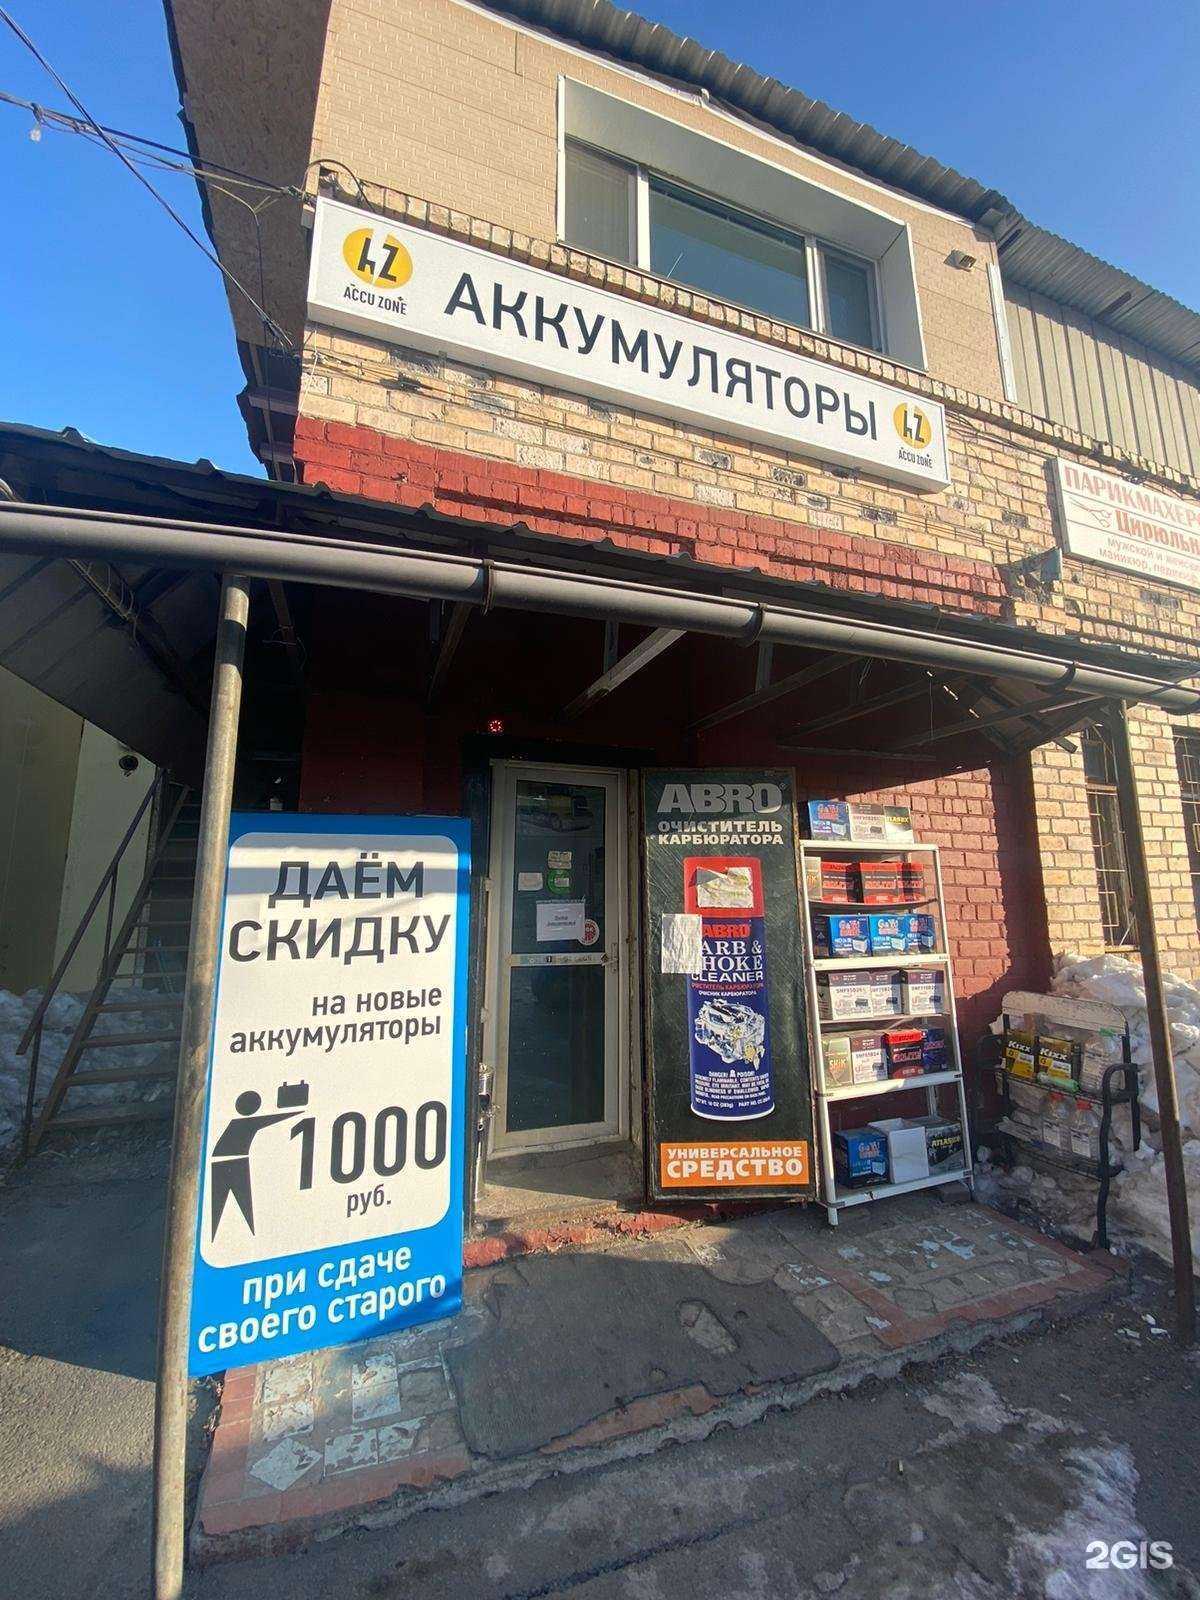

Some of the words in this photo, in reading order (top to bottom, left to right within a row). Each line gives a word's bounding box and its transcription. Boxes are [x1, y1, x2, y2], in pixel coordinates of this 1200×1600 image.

[343, 284, 375, 306] ACCU
[378, 296, 407, 315] ZONE
[443, 272, 878, 441] АККУМУЛЯТОРЫ
[656, 783, 783, 814] ABRO
[657, 820, 783, 834] ОЧИСТИТЕЛЬ
[657, 834, 784, 846] КАРБЮРАТОРА
[268, 852, 424, 909] ДАЁМ
[228, 914, 451, 965] СКИДКУ
[702, 924, 751, 938] ABRO
[700, 940, 747, 955] ARB
[751, 939, 763, 954] &
[692, 970, 764, 982] CLEANER
[701, 954, 763, 972] HOKE
[312, 994, 345, 1016] на
[356, 987, 442, 1013] новые
[229, 1015, 441, 1057] аккумуляторы
[667, 1146, 803, 1159] УНИВЕРСАЛЬНОЕ
[667, 1158, 803, 1180] СРЕДСТВО
[346, 1184, 392, 1217] руб.
[242, 1266, 306, 1309] при
[317, 1246, 412, 1290] сдаче
[197, 1304, 317, 1353] своего
[327, 1274, 446, 1320] старого
